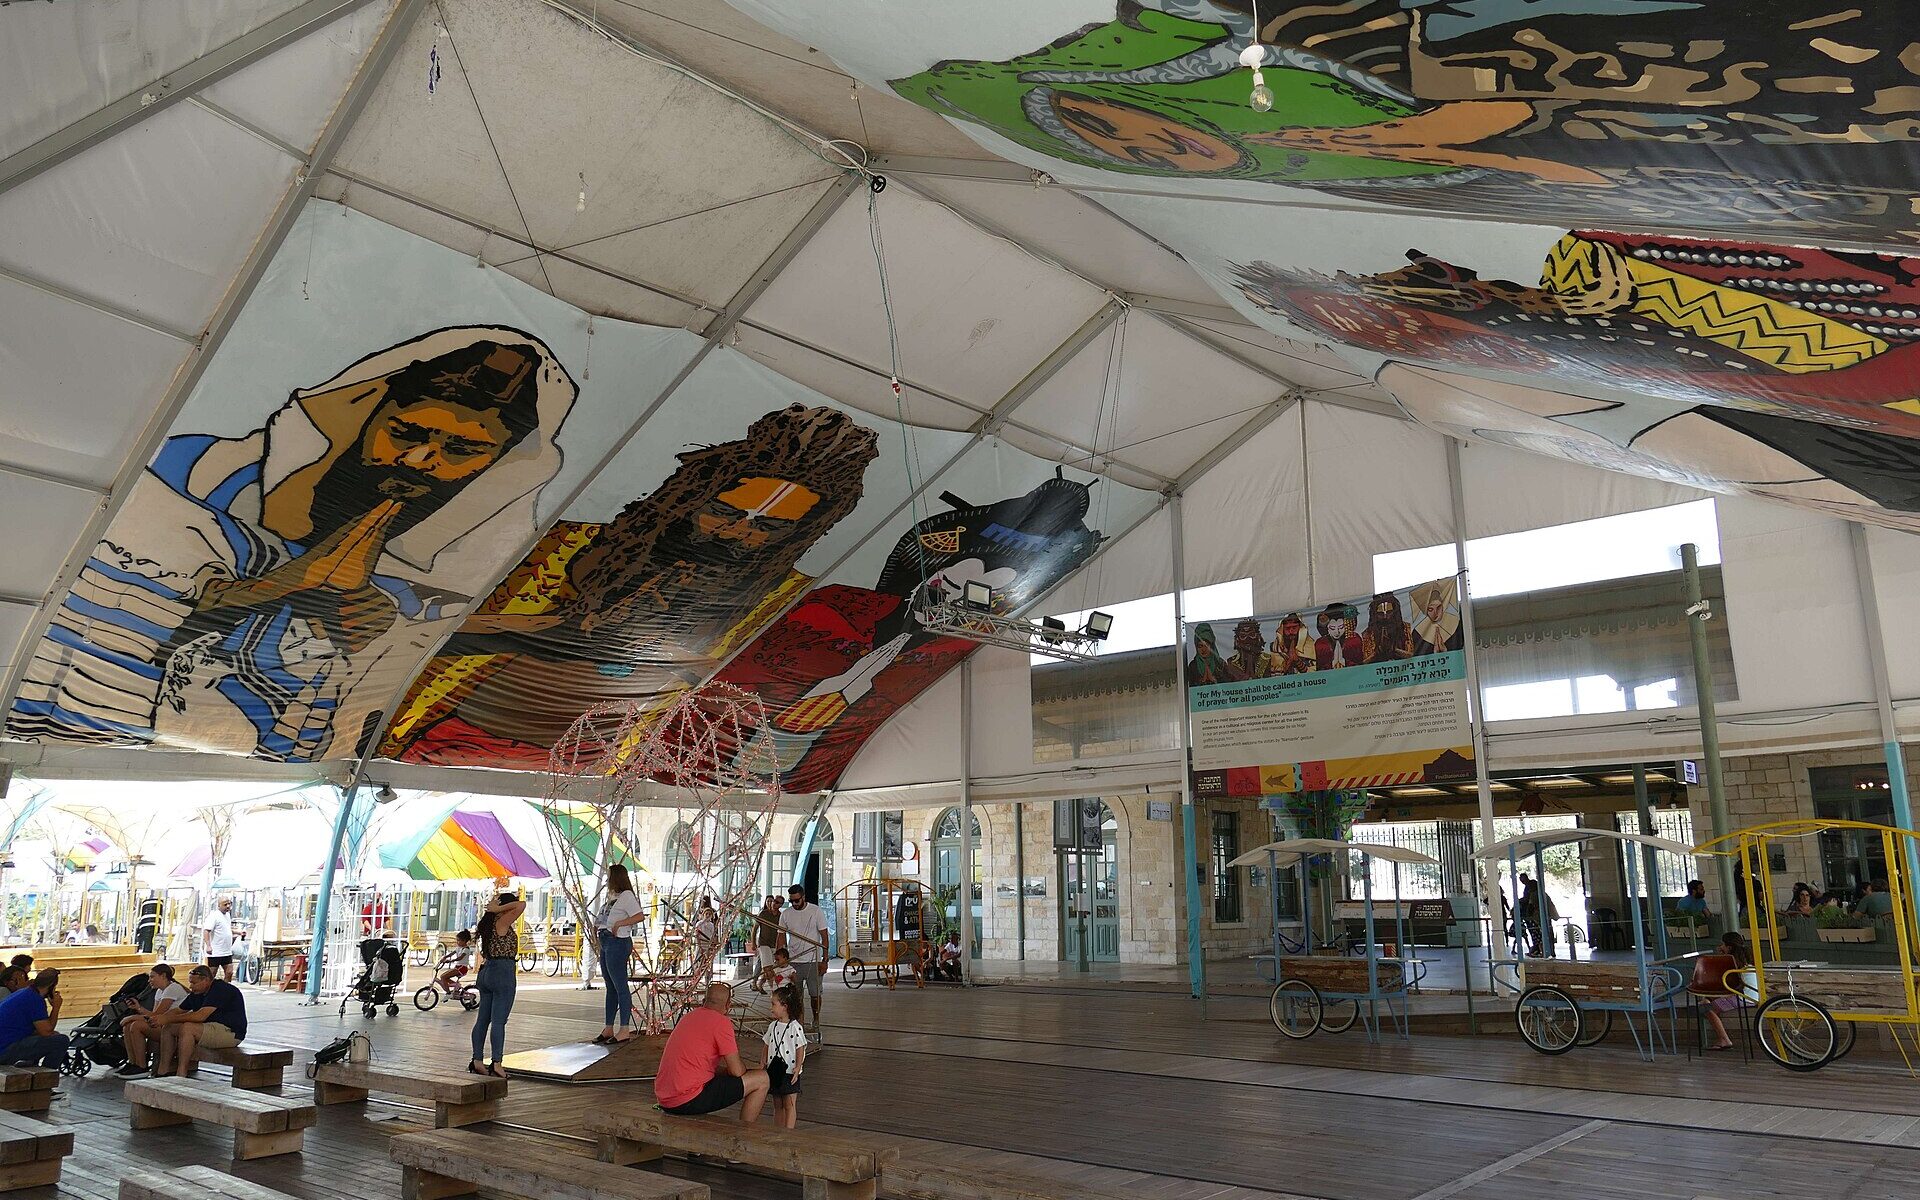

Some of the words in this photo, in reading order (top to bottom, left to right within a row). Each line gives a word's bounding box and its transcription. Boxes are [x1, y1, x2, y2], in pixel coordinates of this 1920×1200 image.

[1197, 691, 1209, 699] "for
[1211, 690, 1220, 698] My
[1221, 687, 1244, 697] house
[1245, 685, 1261, 694] shall
[1262, 684, 1271, 692] be
[1272, 681, 1296, 691] called
[1304, 677, 1327, 687] house
[1206, 698, 1228, 707] prayer
[1252, 691, 1282, 701] peoples"
